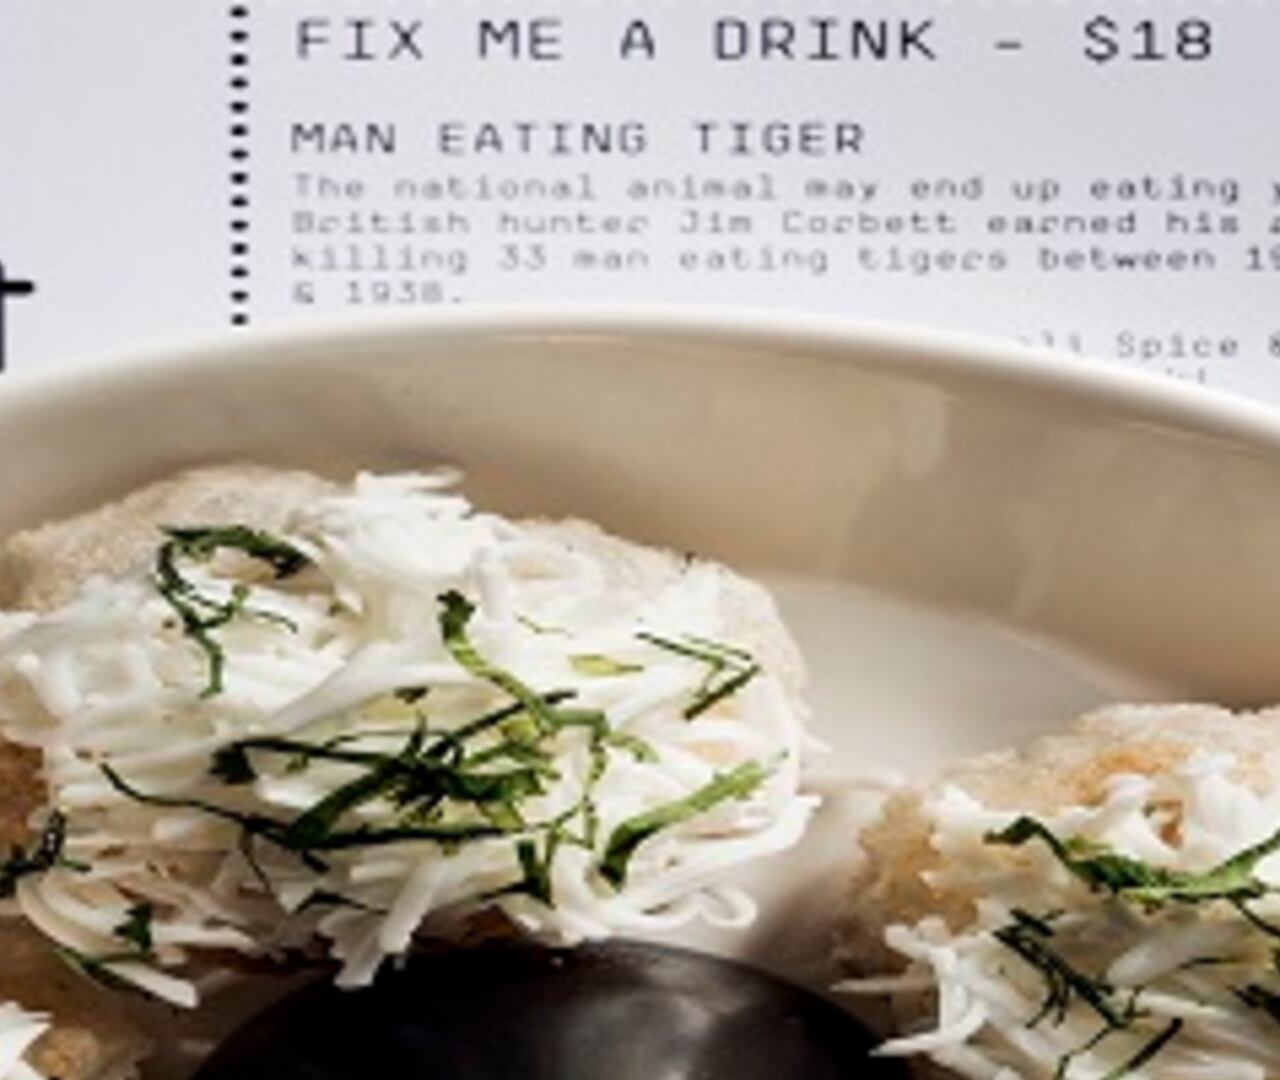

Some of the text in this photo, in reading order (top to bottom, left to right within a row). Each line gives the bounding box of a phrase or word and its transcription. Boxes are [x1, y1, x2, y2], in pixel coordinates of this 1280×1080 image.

[296, 18, 424, 62] FIX
[477, 18, 562, 62] ME
[619, 18, 656, 60] A
[713, 16, 937, 62] DRINK
[1083, 14, 1213, 66] $18
[290, 121, 865, 157] MAN EATING TIGER
[294, 171, 366, 201] The
[393, 172, 595, 202] national
[625, 172, 776, 202] animal
[803, 178, 878, 202] may
[909, 175, 985, 202] end
[1010, 177, 1062, 204] up
[1088, 173, 1240, 205] eating
[291, 209, 471, 236] British
[498, 211, 650, 236] hunter
[678, 208, 754, 236] Jim
[780, 208, 956, 236] Corbett
[985, 211, 1137, 236] earned
[1165, 210, 1240, 236] his
